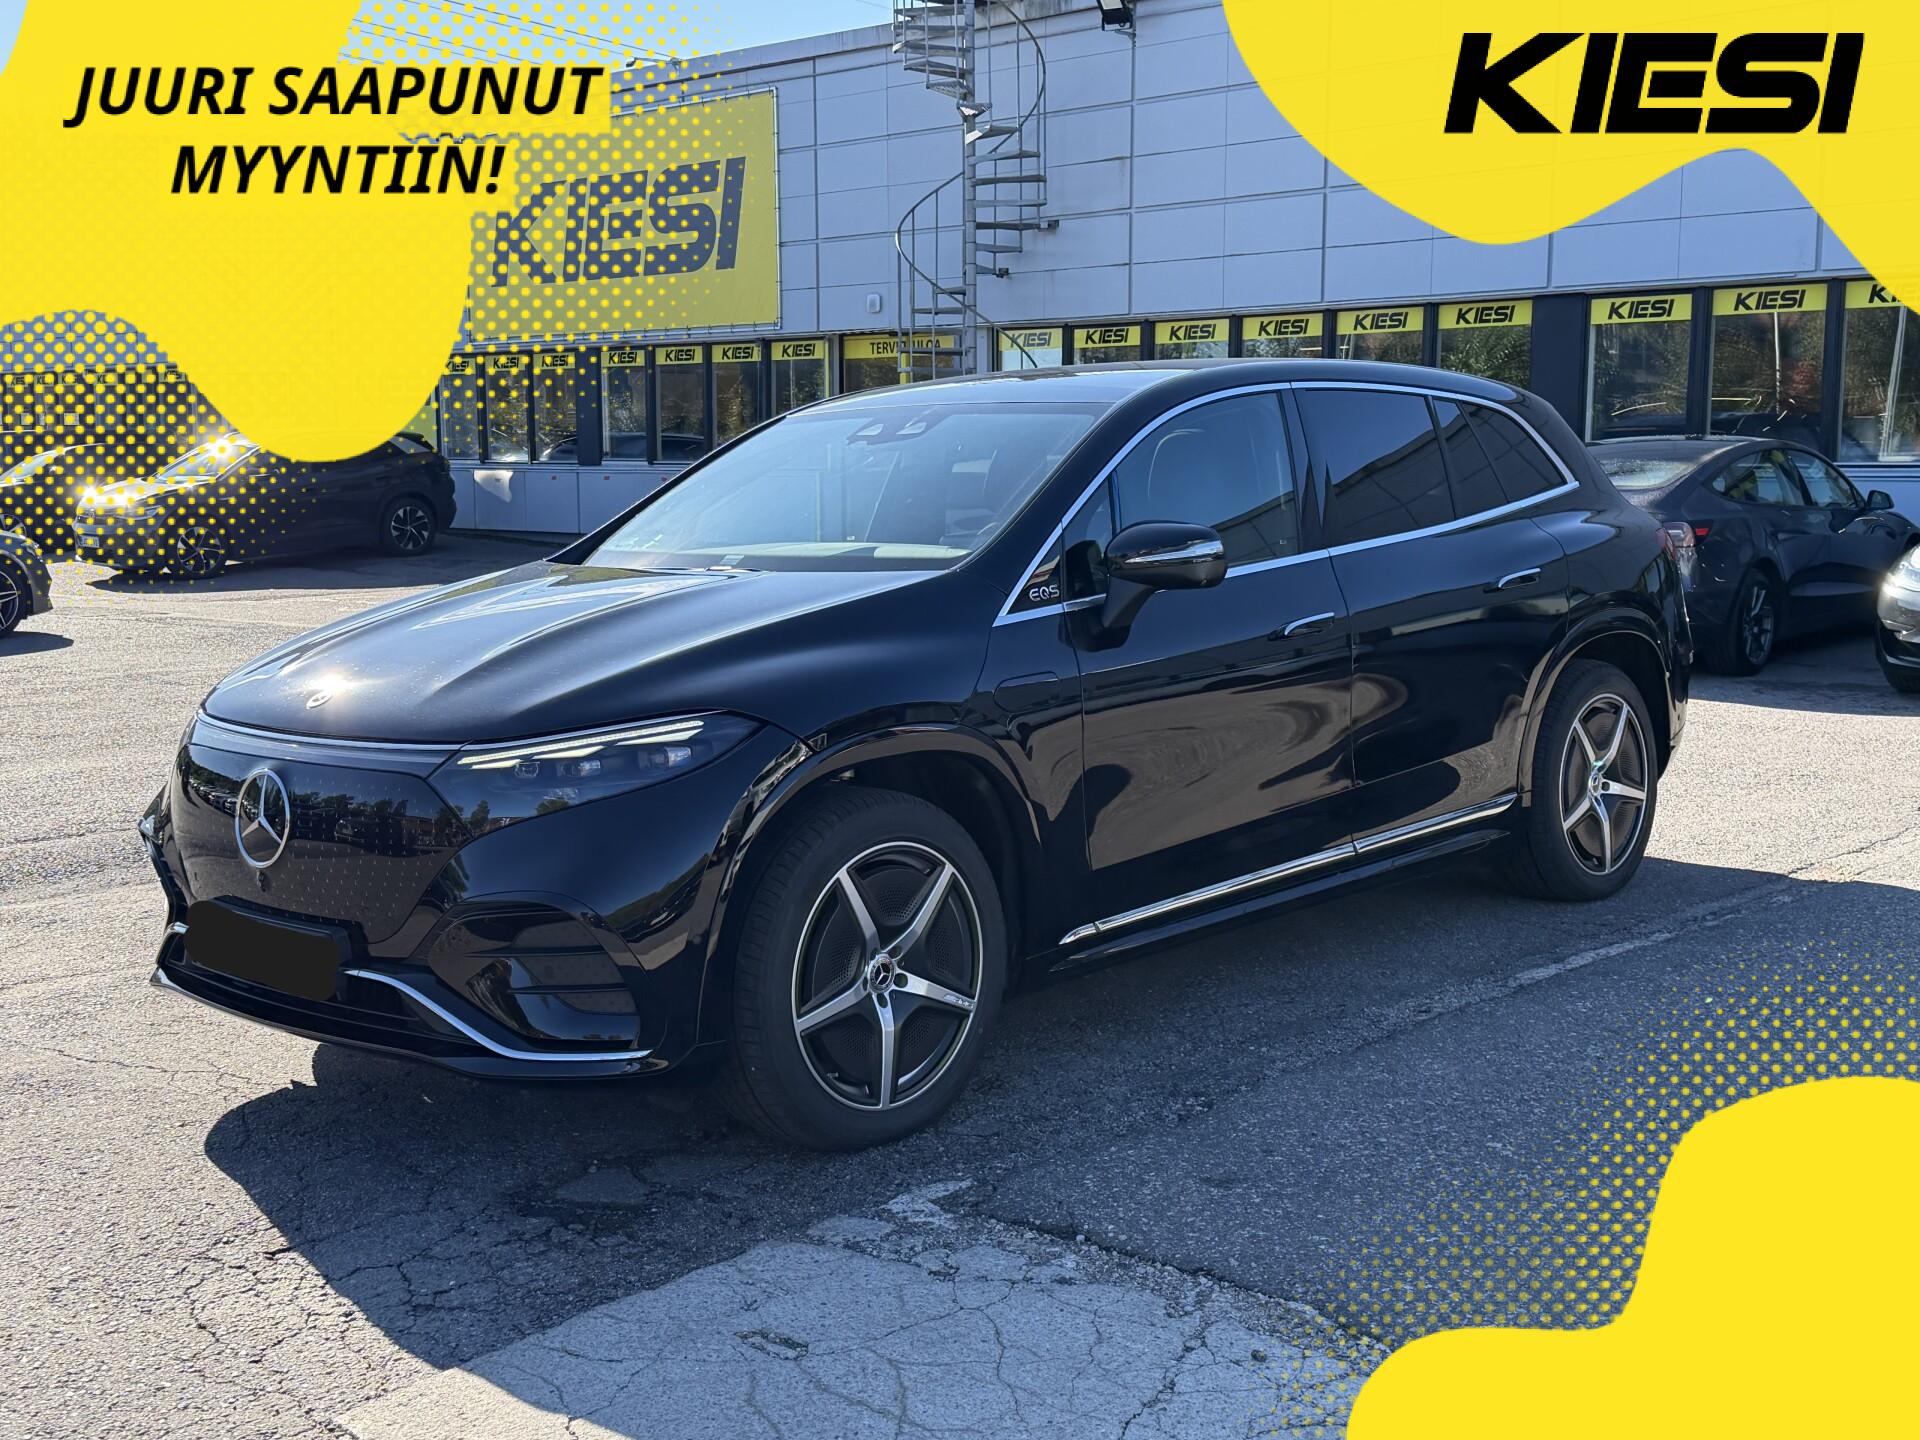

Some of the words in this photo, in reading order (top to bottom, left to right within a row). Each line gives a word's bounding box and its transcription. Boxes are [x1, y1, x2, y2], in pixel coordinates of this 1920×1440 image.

[491, 156, 747, 287] KIESI
[1608, 298, 1675, 320] KIESI
[1733, 289, 1806, 311] KIESI
[1353, 311, 1408, 331] KIESI
[1456, 305, 1516, 325] KIESI
[1085, 327, 1129, 345] KIESI
[1169, 323, 1217, 341] KIESI
[1258, 318, 1310, 337] KIESI
[1010, 331, 1052, 348] KIESI
[608, 351, 637, 364] KIESI
[665, 349, 696, 362] KIESI
[721, 346, 753, 360] KIESI
[781, 343, 816, 358] KIESI
[1029, 584, 1060, 601] EQS
